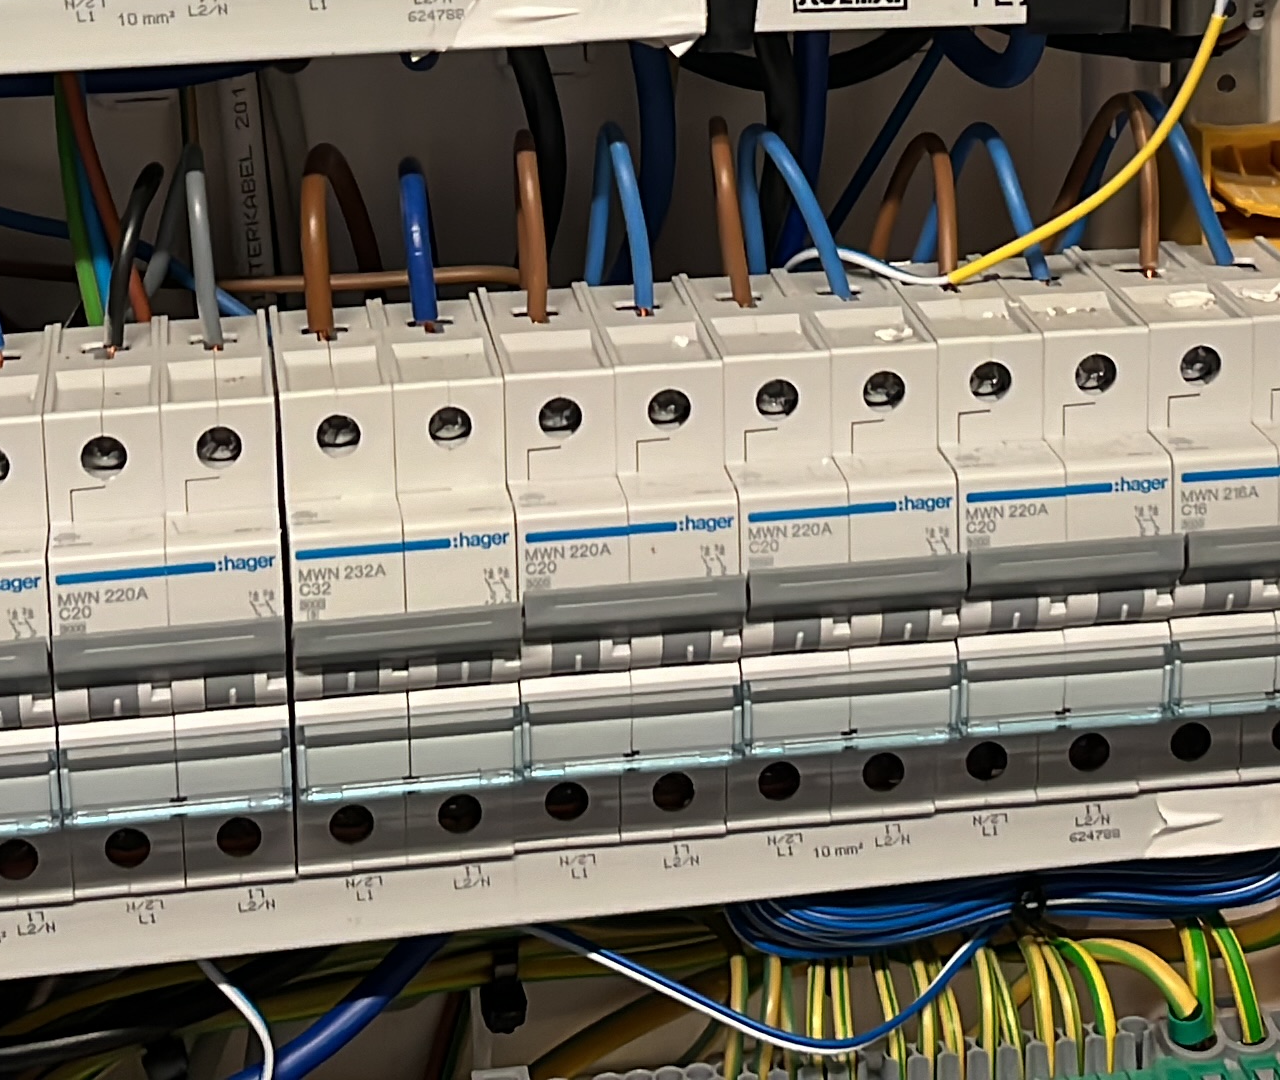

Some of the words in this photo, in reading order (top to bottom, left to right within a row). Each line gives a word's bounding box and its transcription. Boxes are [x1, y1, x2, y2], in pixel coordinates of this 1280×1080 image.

[118, 11, 137, 27] 10
[965, 504, 1006, 521] MWN
[1008, 502, 1049, 518] 220A
[1181, 501, 1208, 516] C16
[748, 525, 789, 541] MWN
[791, 522, 833, 538] 220A
[966, 520, 997, 534] C20
[525, 546, 566, 562] MWN
[569, 543, 612, 559] 220A
[748, 539, 780, 554] C20
[298, 566, 340, 582] MWN
[343, 563, 387, 580] 232A
[525, 560, 557, 576] C20
[299, 581, 332, 597] C32
[57, 591, 101, 608] MWN
[104, 587, 149, 604] 220A
[59, 605, 92, 620] C20
[812, 845, 831, 859] 10
